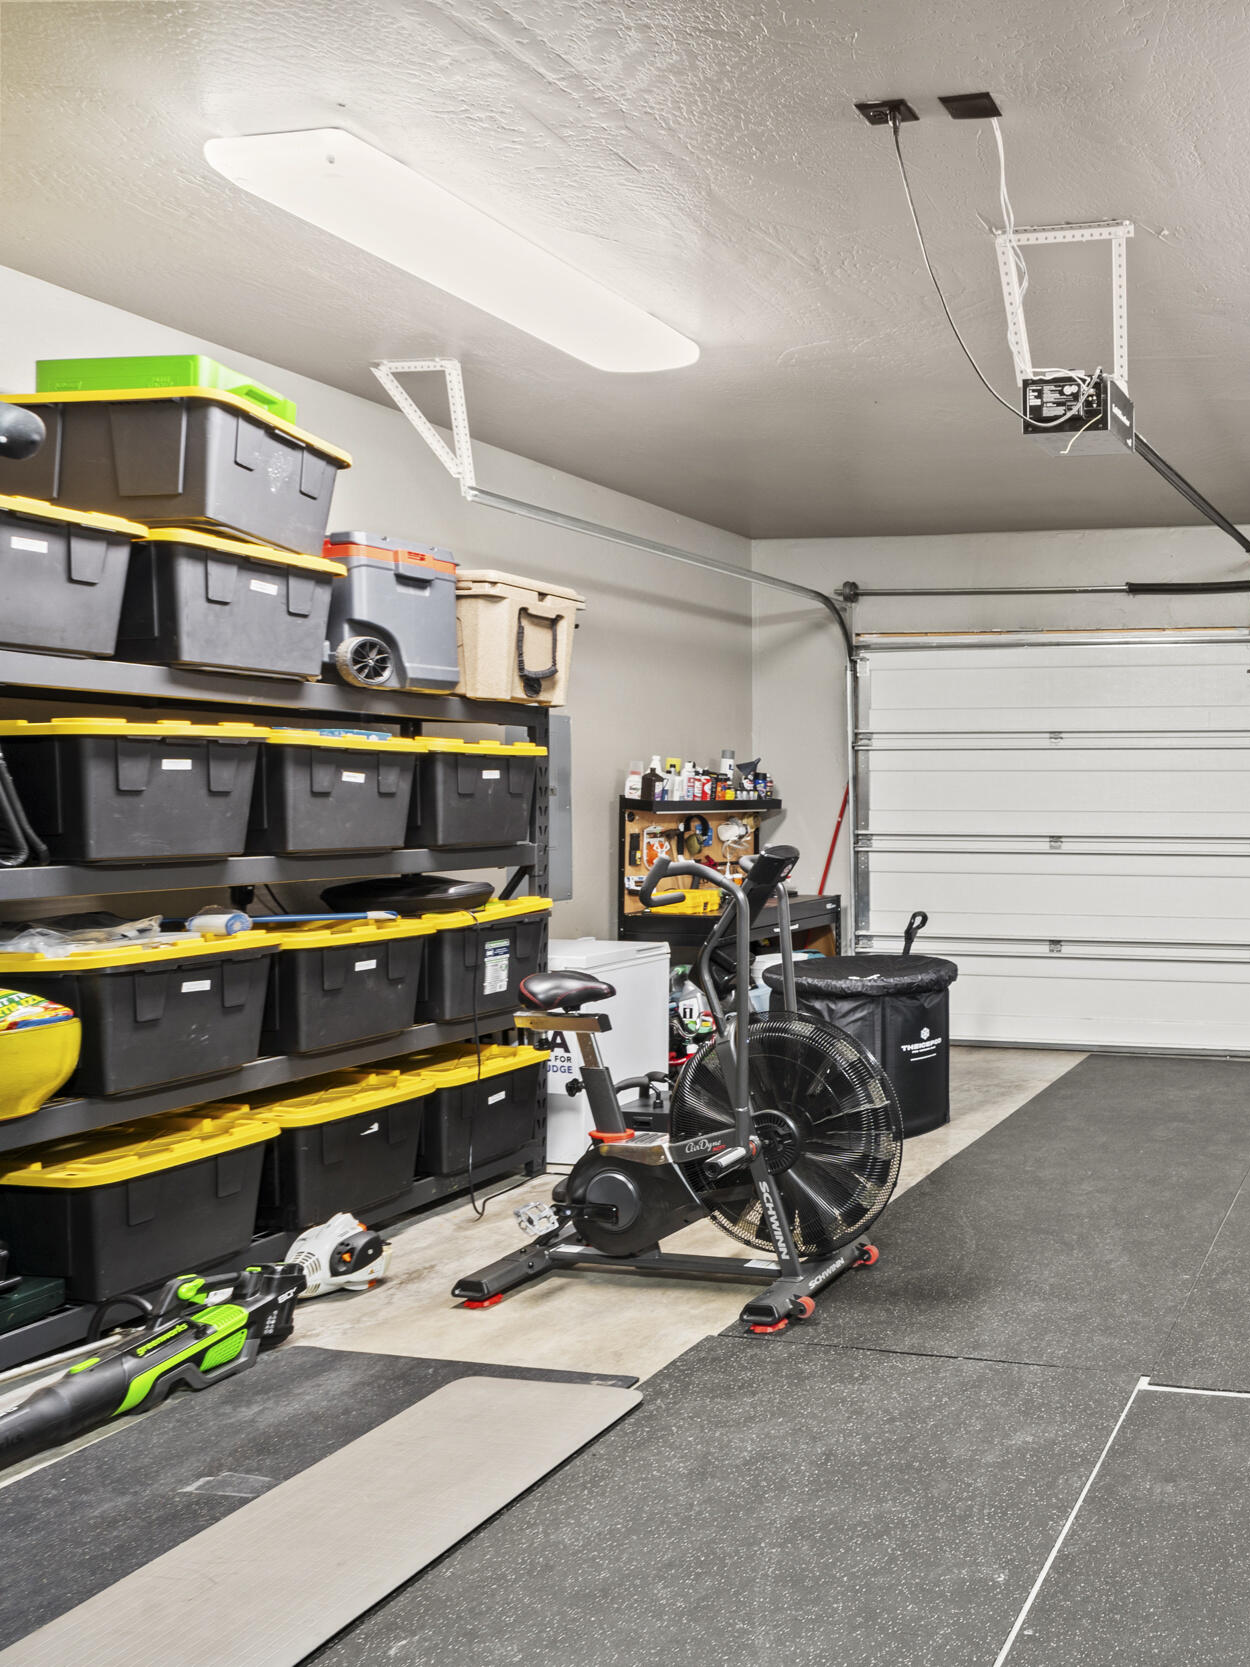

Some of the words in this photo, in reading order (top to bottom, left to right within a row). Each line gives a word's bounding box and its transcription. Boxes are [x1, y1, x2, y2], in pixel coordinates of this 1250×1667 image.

[554, 1055, 572, 1063] FOR
[759, 1181, 791, 1260] SCHWINN
[808, 1257, 845, 1290] SCHWINN
[136, 1323, 189, 1357] greenworks
